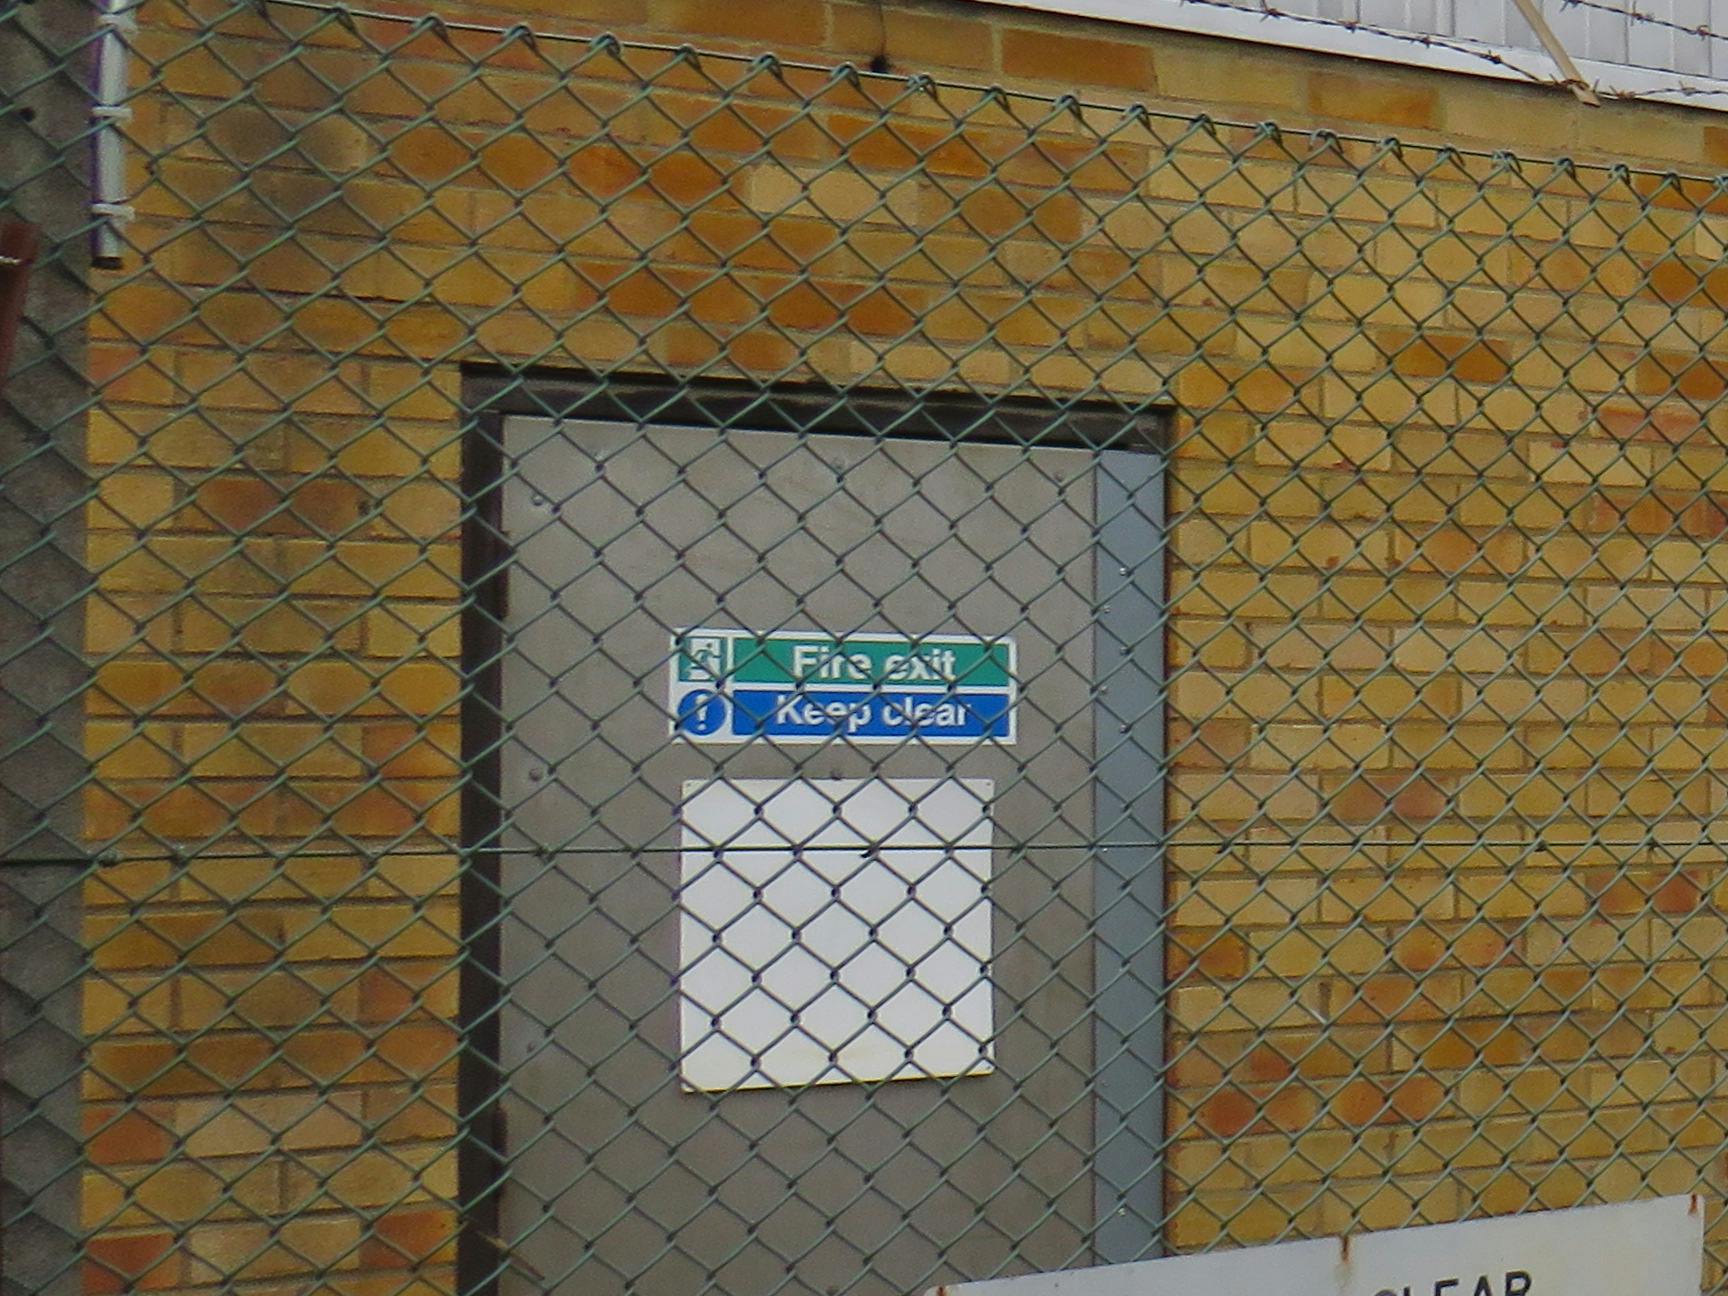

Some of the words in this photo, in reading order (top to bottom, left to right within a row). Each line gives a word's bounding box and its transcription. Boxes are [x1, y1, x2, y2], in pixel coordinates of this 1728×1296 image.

[792, 645, 873, 680] Fire
[884, 648, 957, 681] exit
[776, 693, 873, 734] Keep
[882, 696, 972, 727] clear
